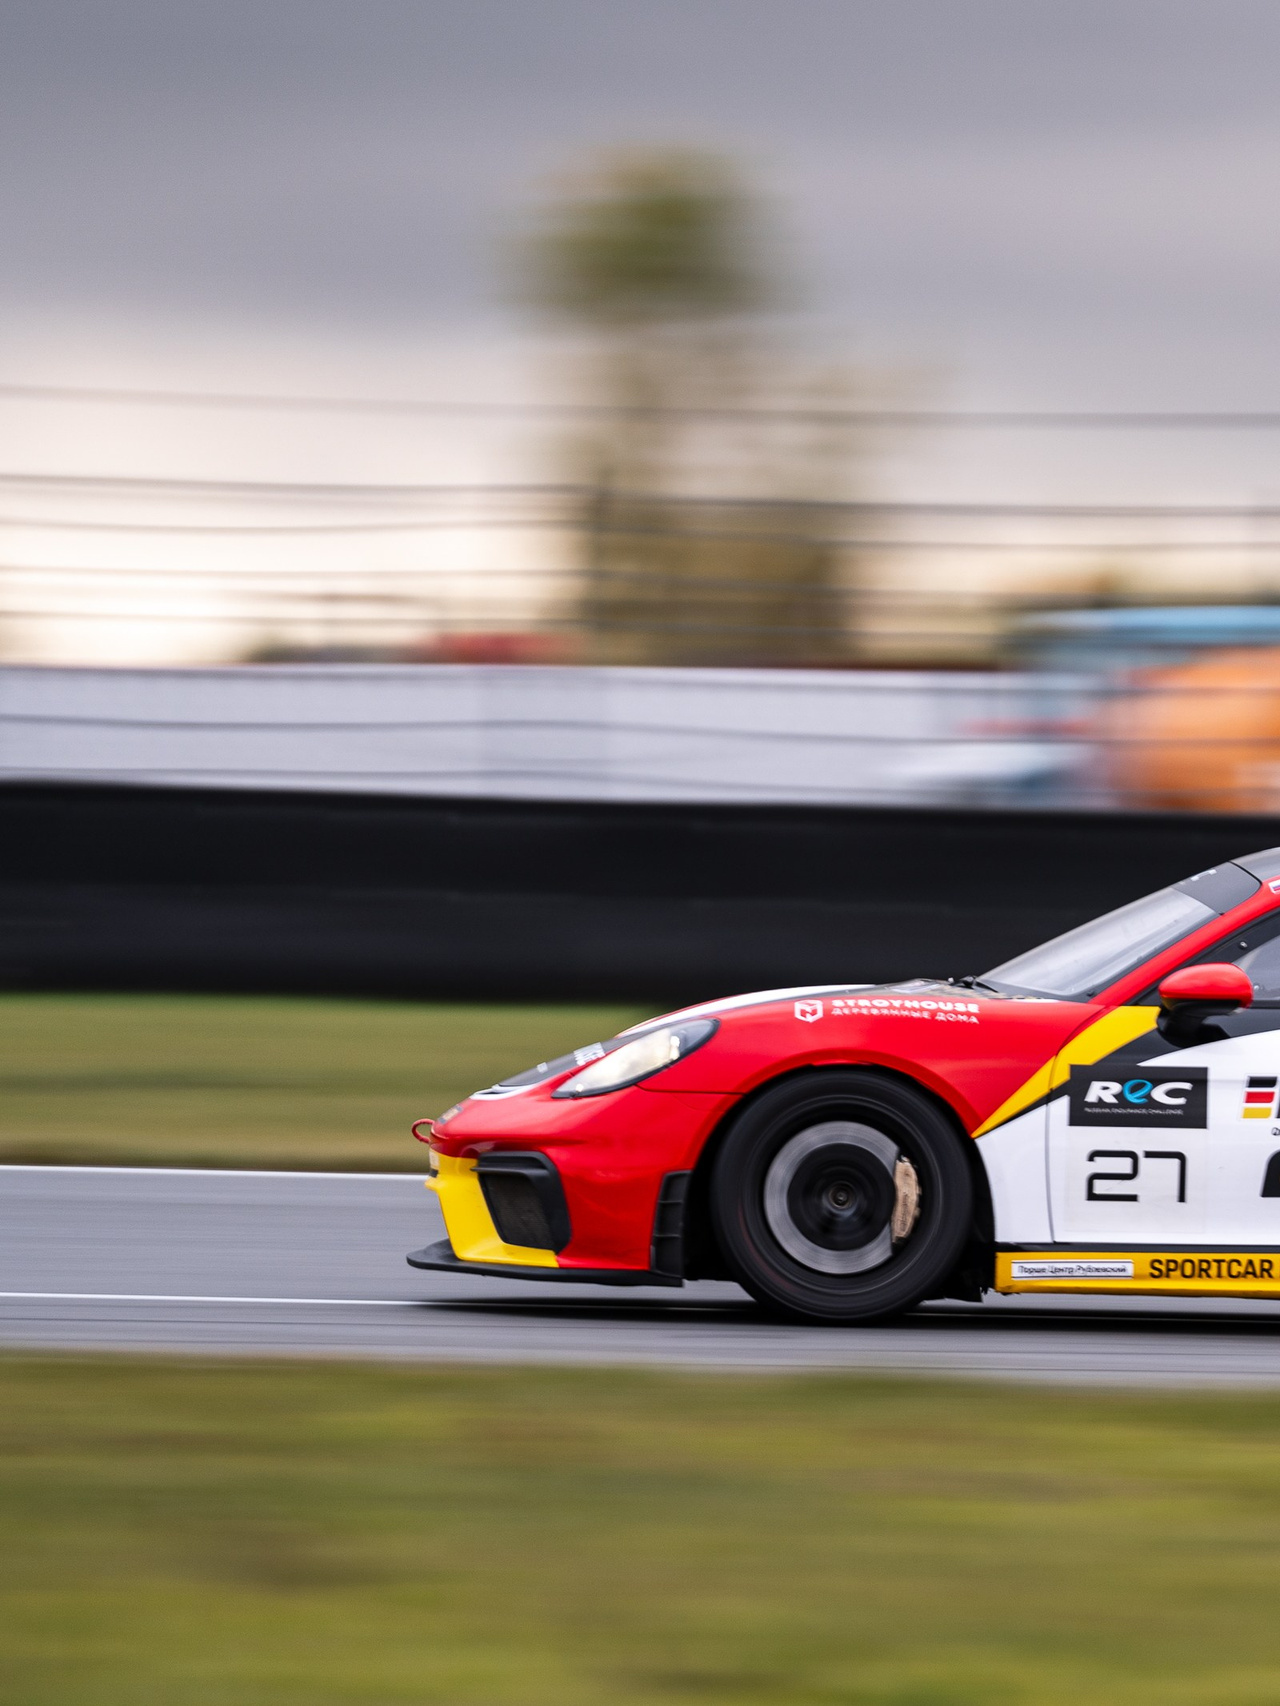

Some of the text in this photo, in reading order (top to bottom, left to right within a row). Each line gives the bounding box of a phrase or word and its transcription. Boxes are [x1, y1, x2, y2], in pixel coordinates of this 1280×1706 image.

[831, 998, 980, 1013] STROYHOUSE
[831, 1007, 980, 1024] ДЕРЕВЯННЫЕ ДОМА
[1085, 1149, 1187, 1203] 27
[1149, 1258, 1275, 1279] SPORTCAR
